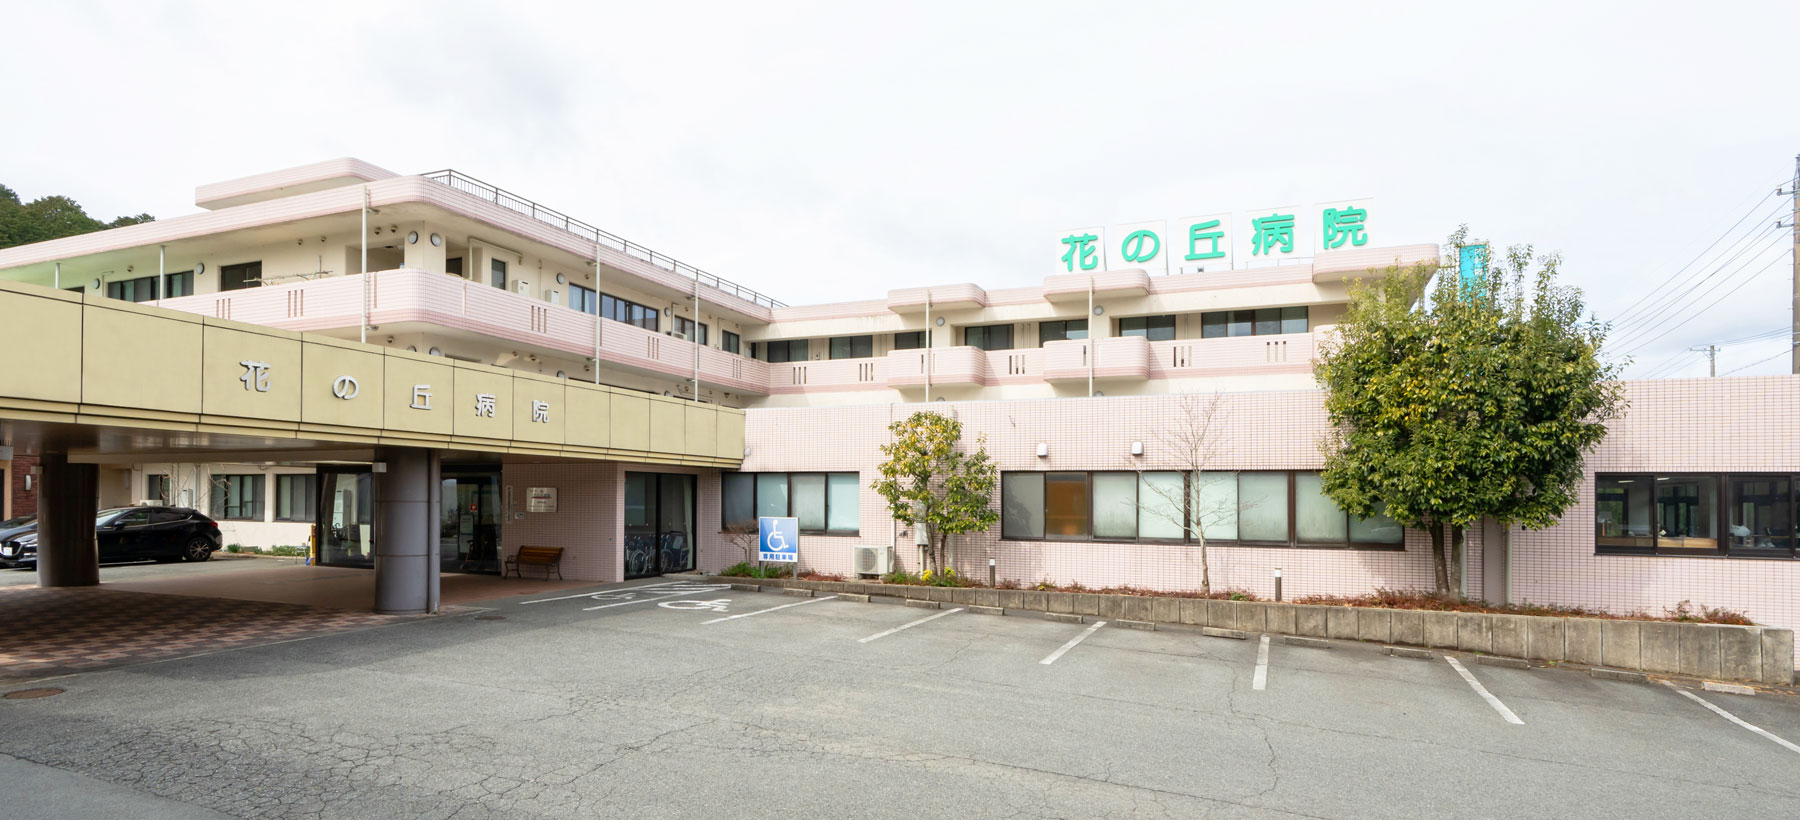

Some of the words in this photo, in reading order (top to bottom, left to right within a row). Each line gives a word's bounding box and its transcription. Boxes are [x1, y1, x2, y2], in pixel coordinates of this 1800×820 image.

[1061, 206, 1368, 272] 花の丘病院
[239, 360, 551, 423] 花の丘病院
